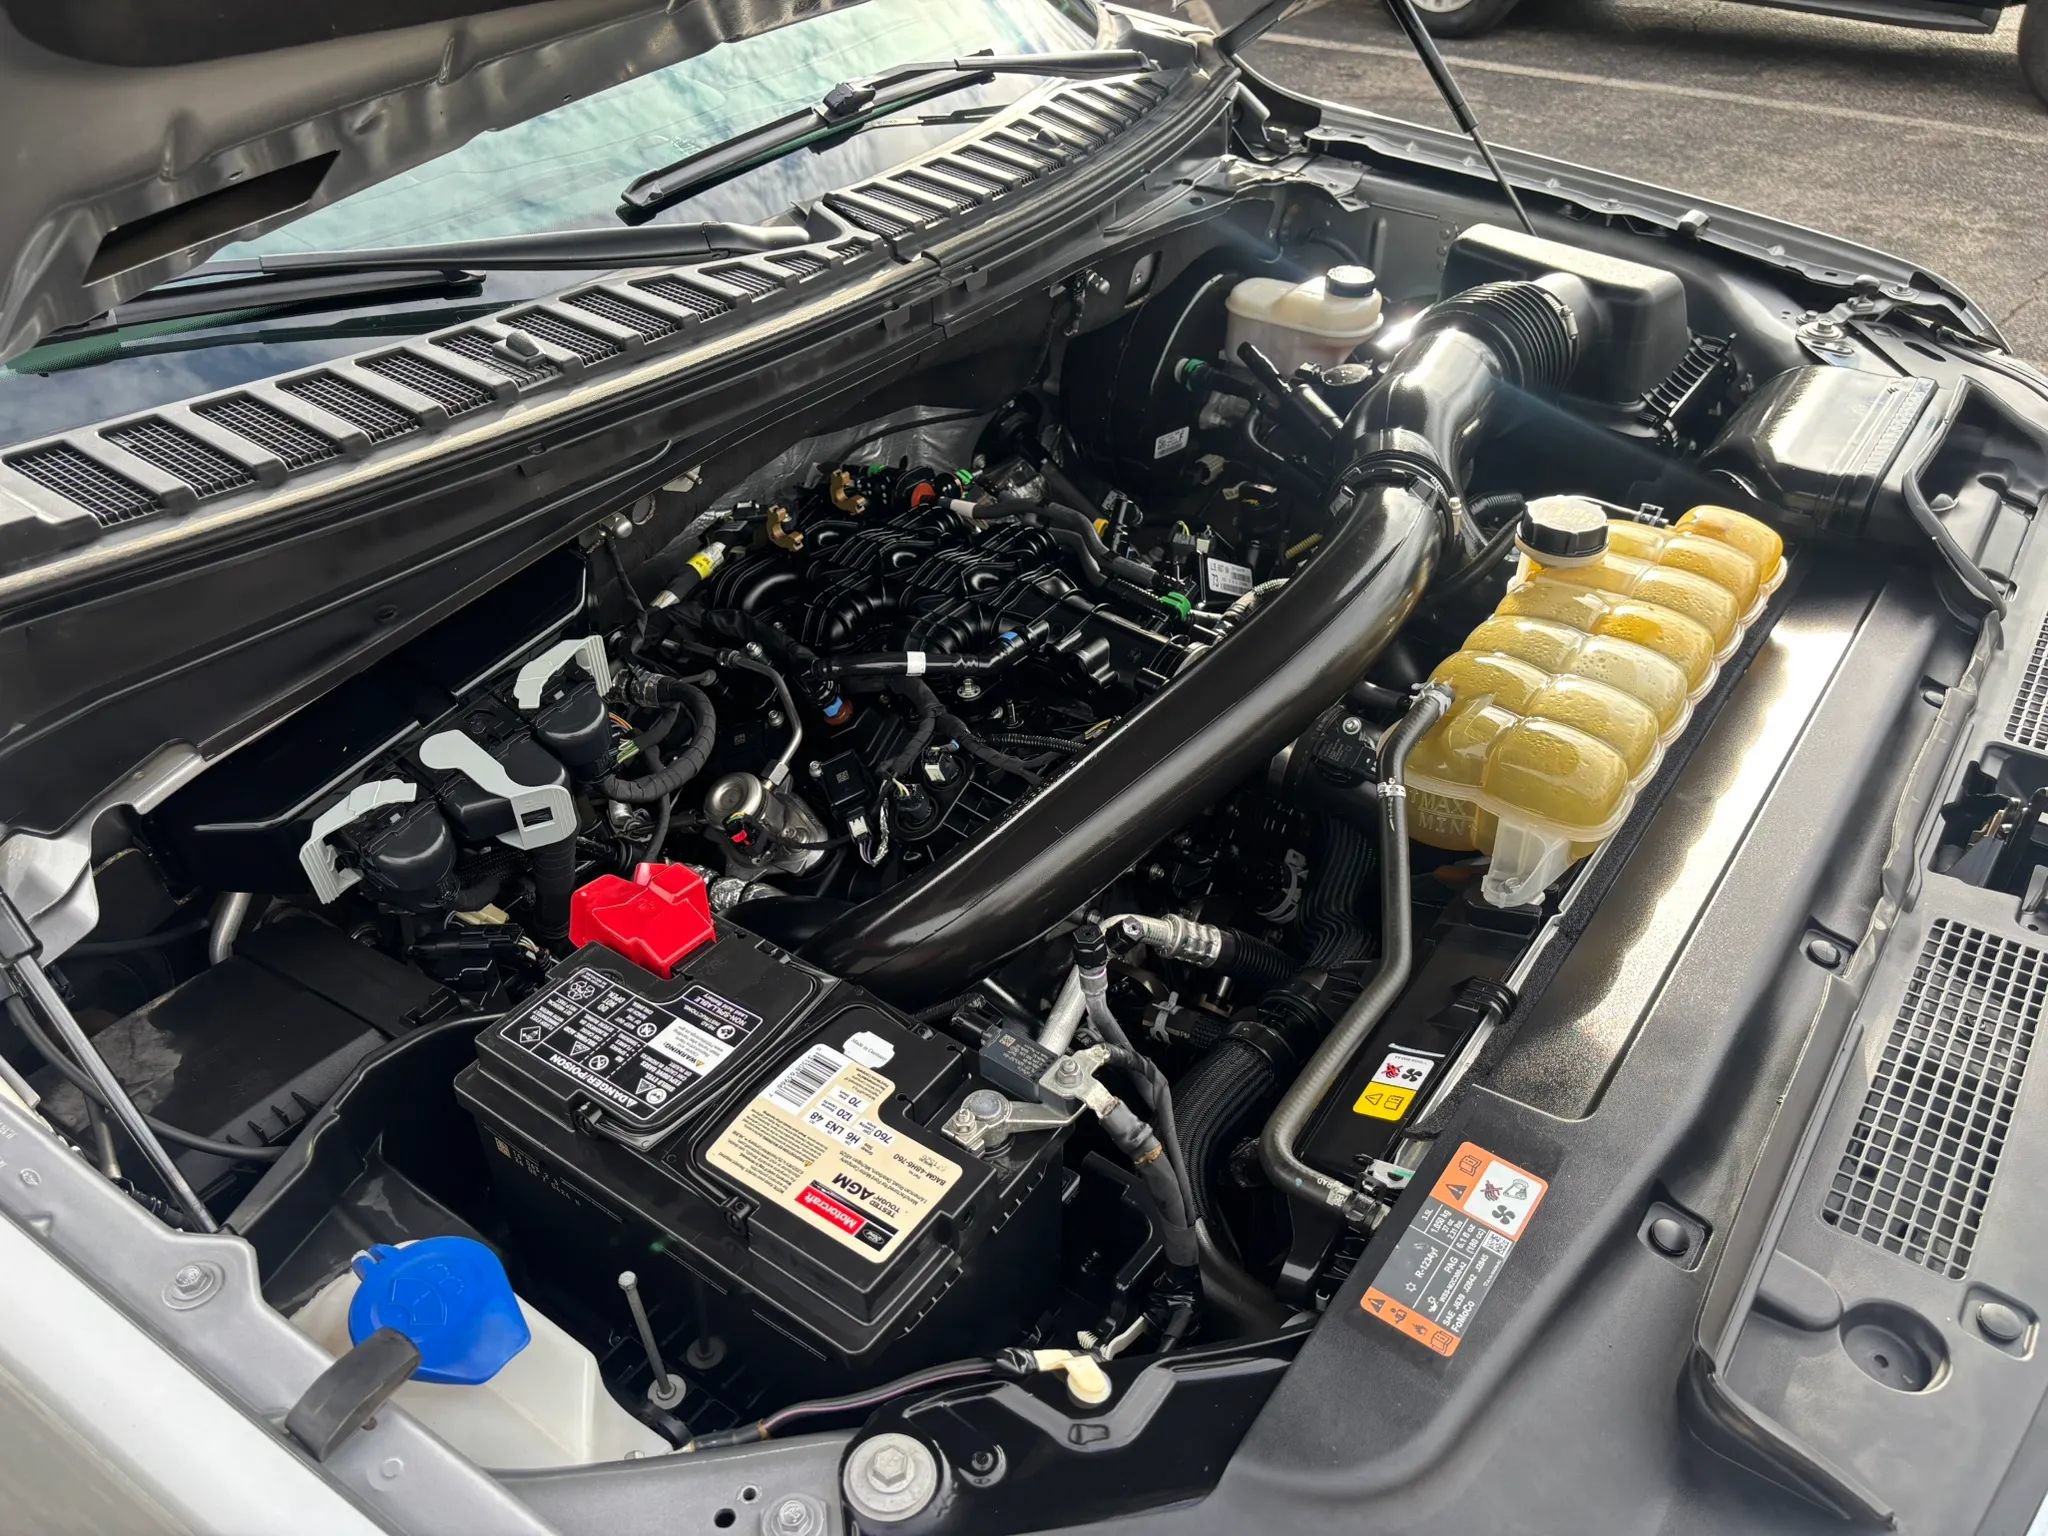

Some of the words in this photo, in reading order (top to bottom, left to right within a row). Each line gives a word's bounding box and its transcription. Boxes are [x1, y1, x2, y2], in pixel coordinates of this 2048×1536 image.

[1420, 791, 1465, 816] MAX
[1418, 811, 1464, 836] MIN
[602, 998, 617, 1007] NOT
[607, 991, 625, 1003] OPEN.
[597, 1003, 608, 1012] DO
[684, 1005, 720, 1026] INSTRUCTIONS.
[694, 996, 746, 1025] NON-SPILLABLE
[563, 1026, 576, 1034] ACID
[700, 1020, 716, 1030] READ
[574, 1032, 597, 1046] SULFURIC
[614, 1039, 632, 1050] FLAMES
[664, 1043, 696, 1062] WARNING:
[640, 1060, 657, 1072] GASES
[550, 1054, 627, 1102] DANGER/POISON
[655, 1069, 681, 1086] EXPLOSIVE
[848, 1096, 861, 1107] 70
[810, 1111, 823, 1121] 48
[836, 1108, 852, 1121] 120
[825, 1120, 844, 1134] LN3
[845, 1132, 860, 1143] H6
[873, 1129, 892, 1143] 760
[893, 1154, 945, 1185] BAGM-48H6-760
[832, 1173, 874, 1200] AGM
[805, 1193, 856, 1227] Motorcraft
[869, 1200, 894, 1217] TESTED
[1430, 1216, 1444, 1232] 1.050
[1439, 1209, 1451, 1218] kg
[1441, 1224, 1449, 1232] 37
[1455, 1237, 1466, 1248] 6.1
[1467, 1223, 1475, 1232] oz
[1466, 1238, 1478, 1254] (180
[1475, 1228, 1486, 1239] cc)
[1415, 1246, 1437, 1277] R-1234yf
[1444, 1256, 1458, 1273] PAG
[1442, 1310, 1455, 1326] SAE
[1453, 1293, 1465, 1309] J639
[1463, 1274, 1476, 1292] J2842
[1475, 1254, 1488, 1272] J2845
[1451, 1300, 1474, 1332] FoMoCo
